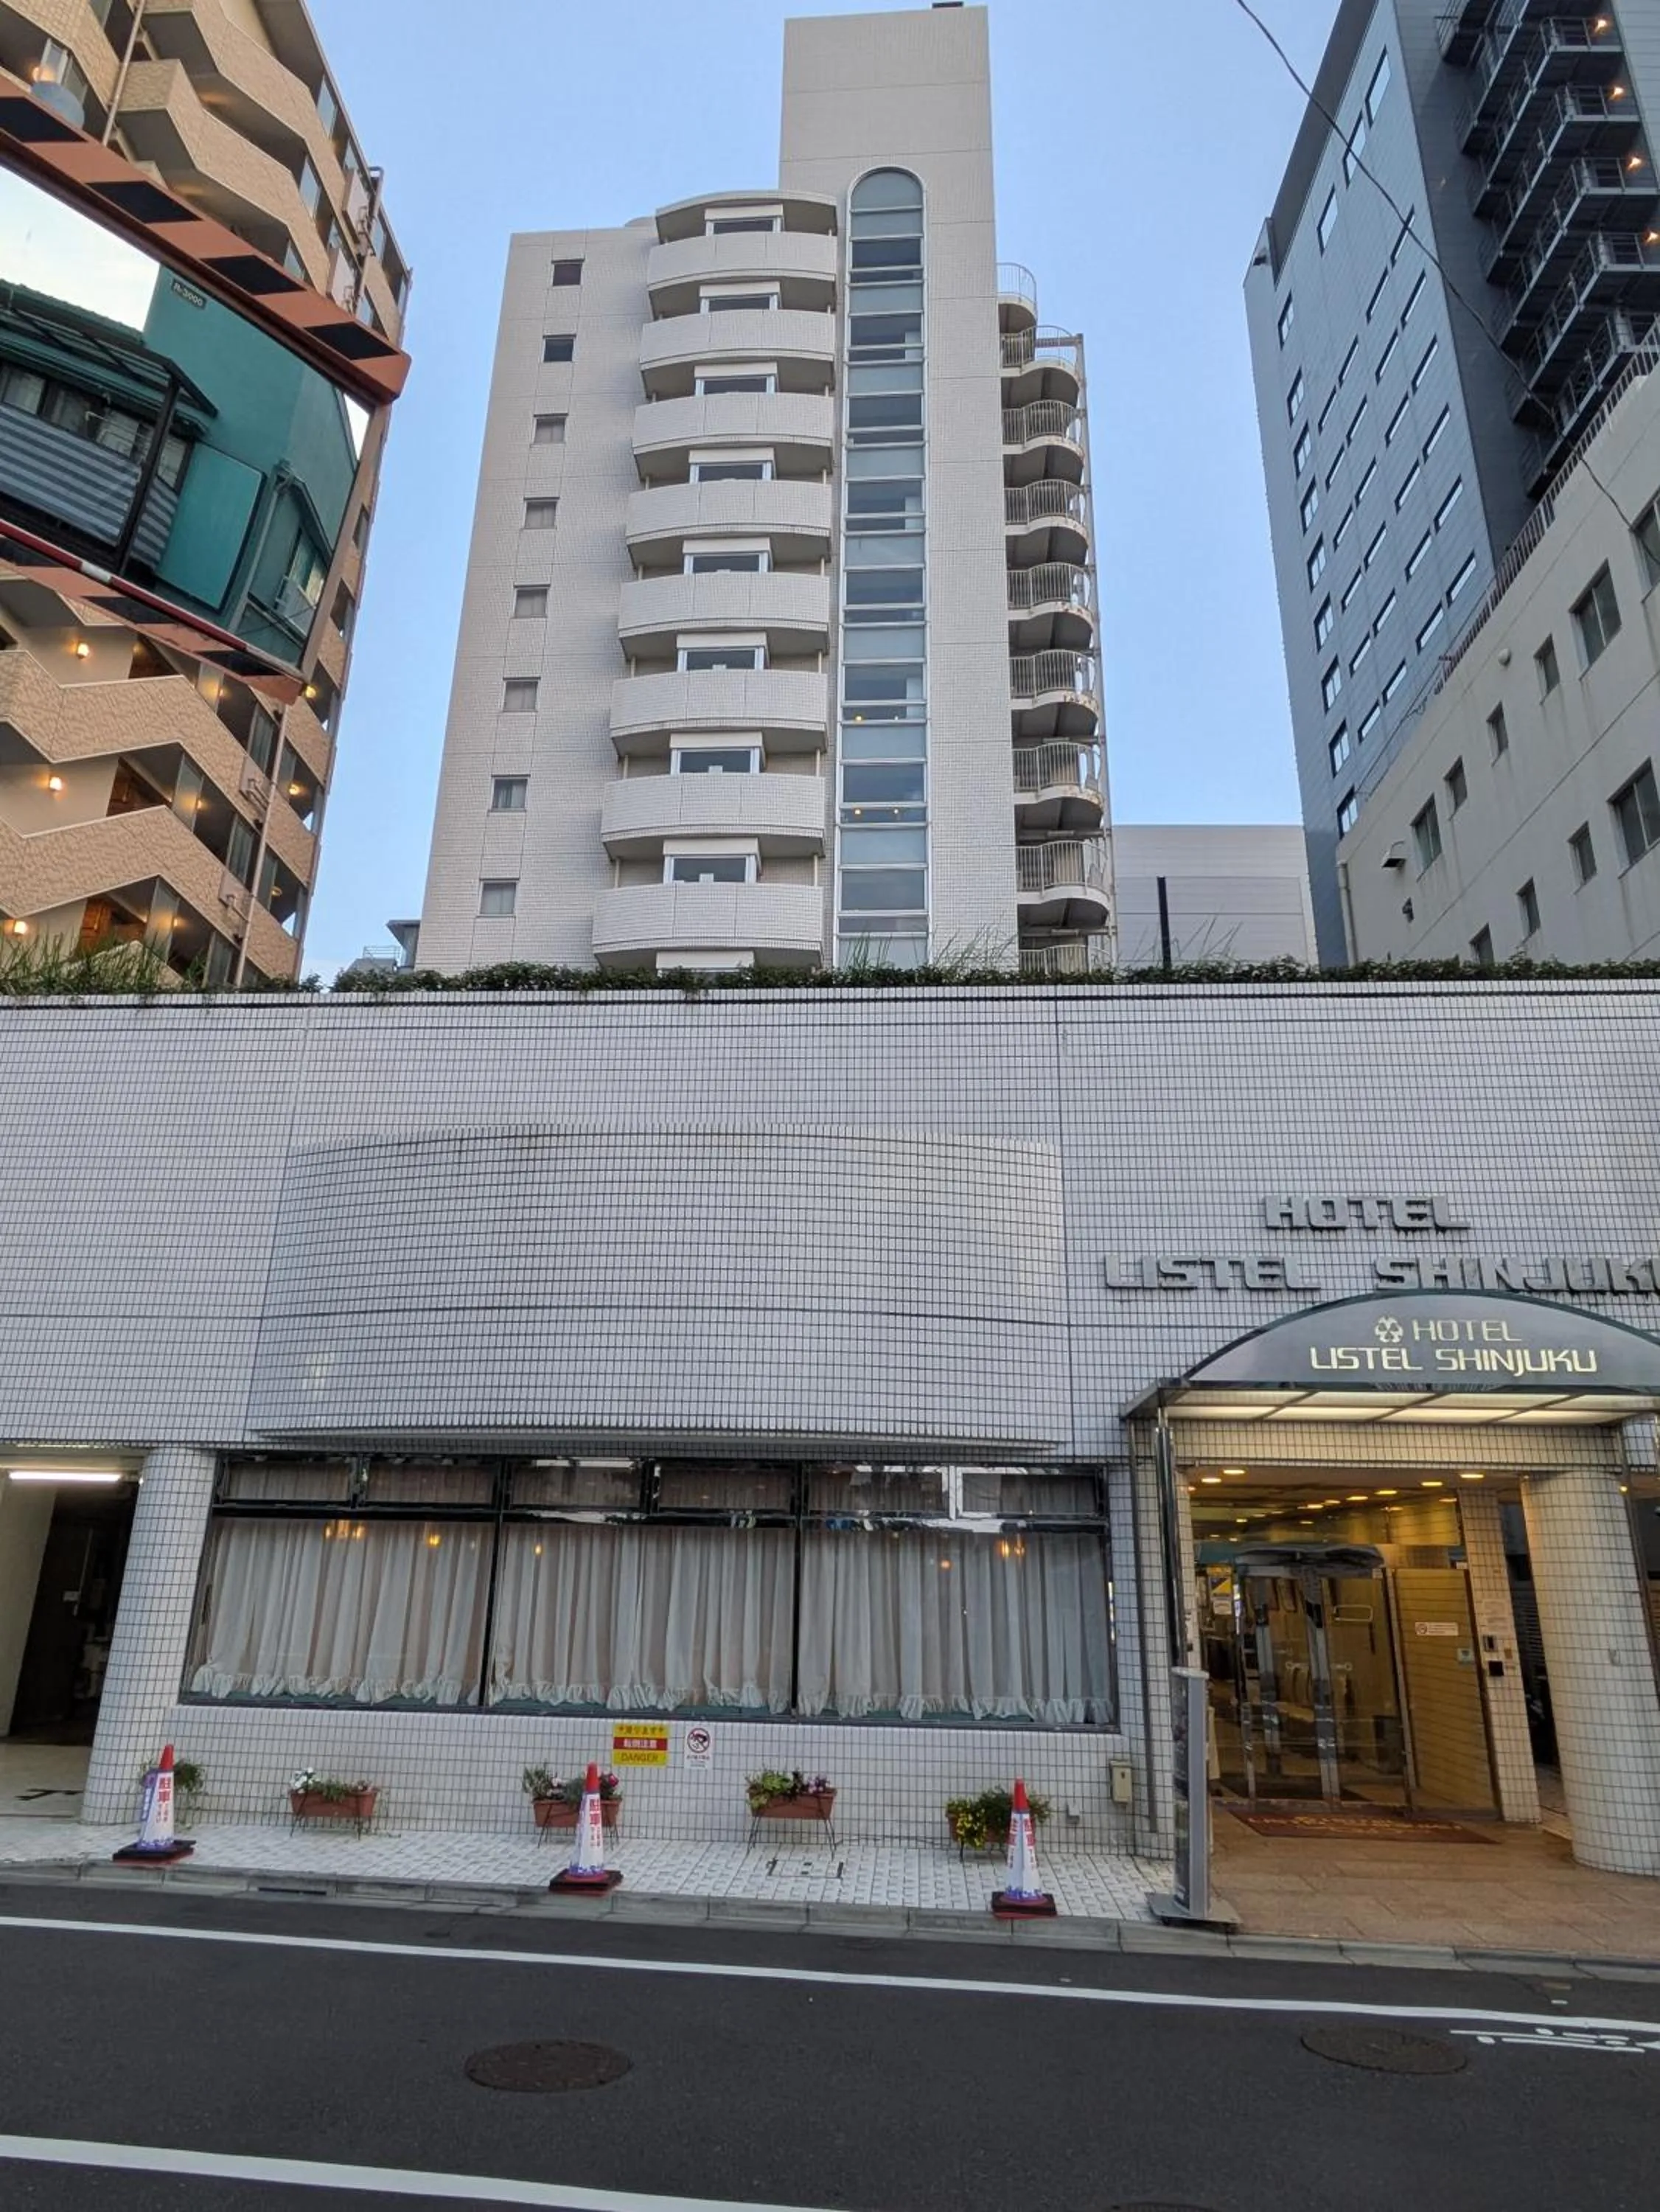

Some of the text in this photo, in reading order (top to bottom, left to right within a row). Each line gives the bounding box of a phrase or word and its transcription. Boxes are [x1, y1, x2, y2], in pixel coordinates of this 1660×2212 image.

[1263, 1194, 1471, 1230] HOTEL
[1106, 1254, 1660, 1293] LISTEL SHINJUK
[1412, 1318, 1522, 1342] HOTEL
[1310, 1346, 1598, 1377] LISTEL SHINJUKU
[621, 1752, 659, 1762] DANGER
